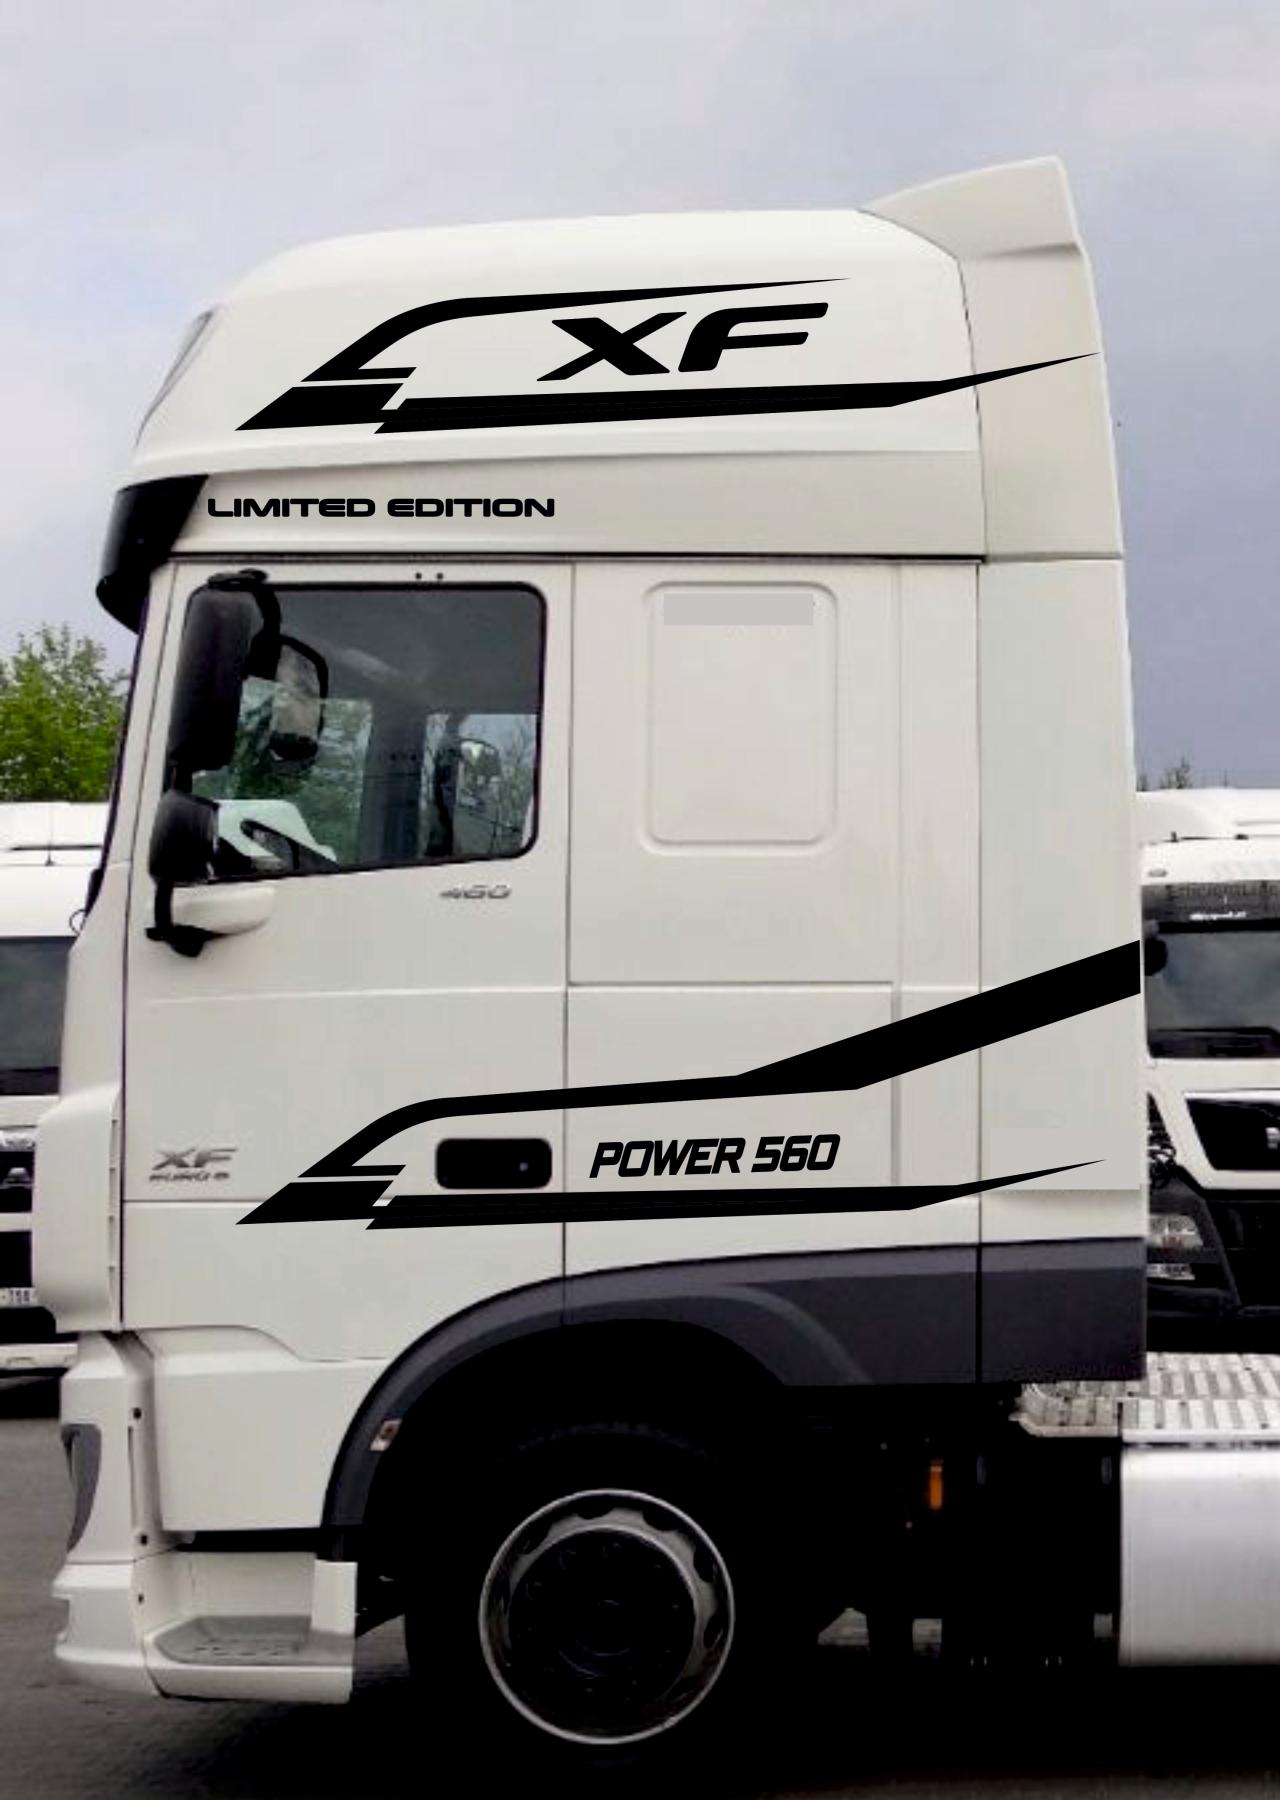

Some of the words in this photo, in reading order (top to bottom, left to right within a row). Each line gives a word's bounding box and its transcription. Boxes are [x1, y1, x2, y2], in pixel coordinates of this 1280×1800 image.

[537, 302, 829, 381] XF
[207, 498, 376, 518] LIMITED
[387, 498, 555, 518] EDITION
[440, 884, 512, 899] 460
[151, 1147, 237, 1170] XF
[589, 1137, 746, 1179] POWER
[751, 1133, 841, 1173] 560
